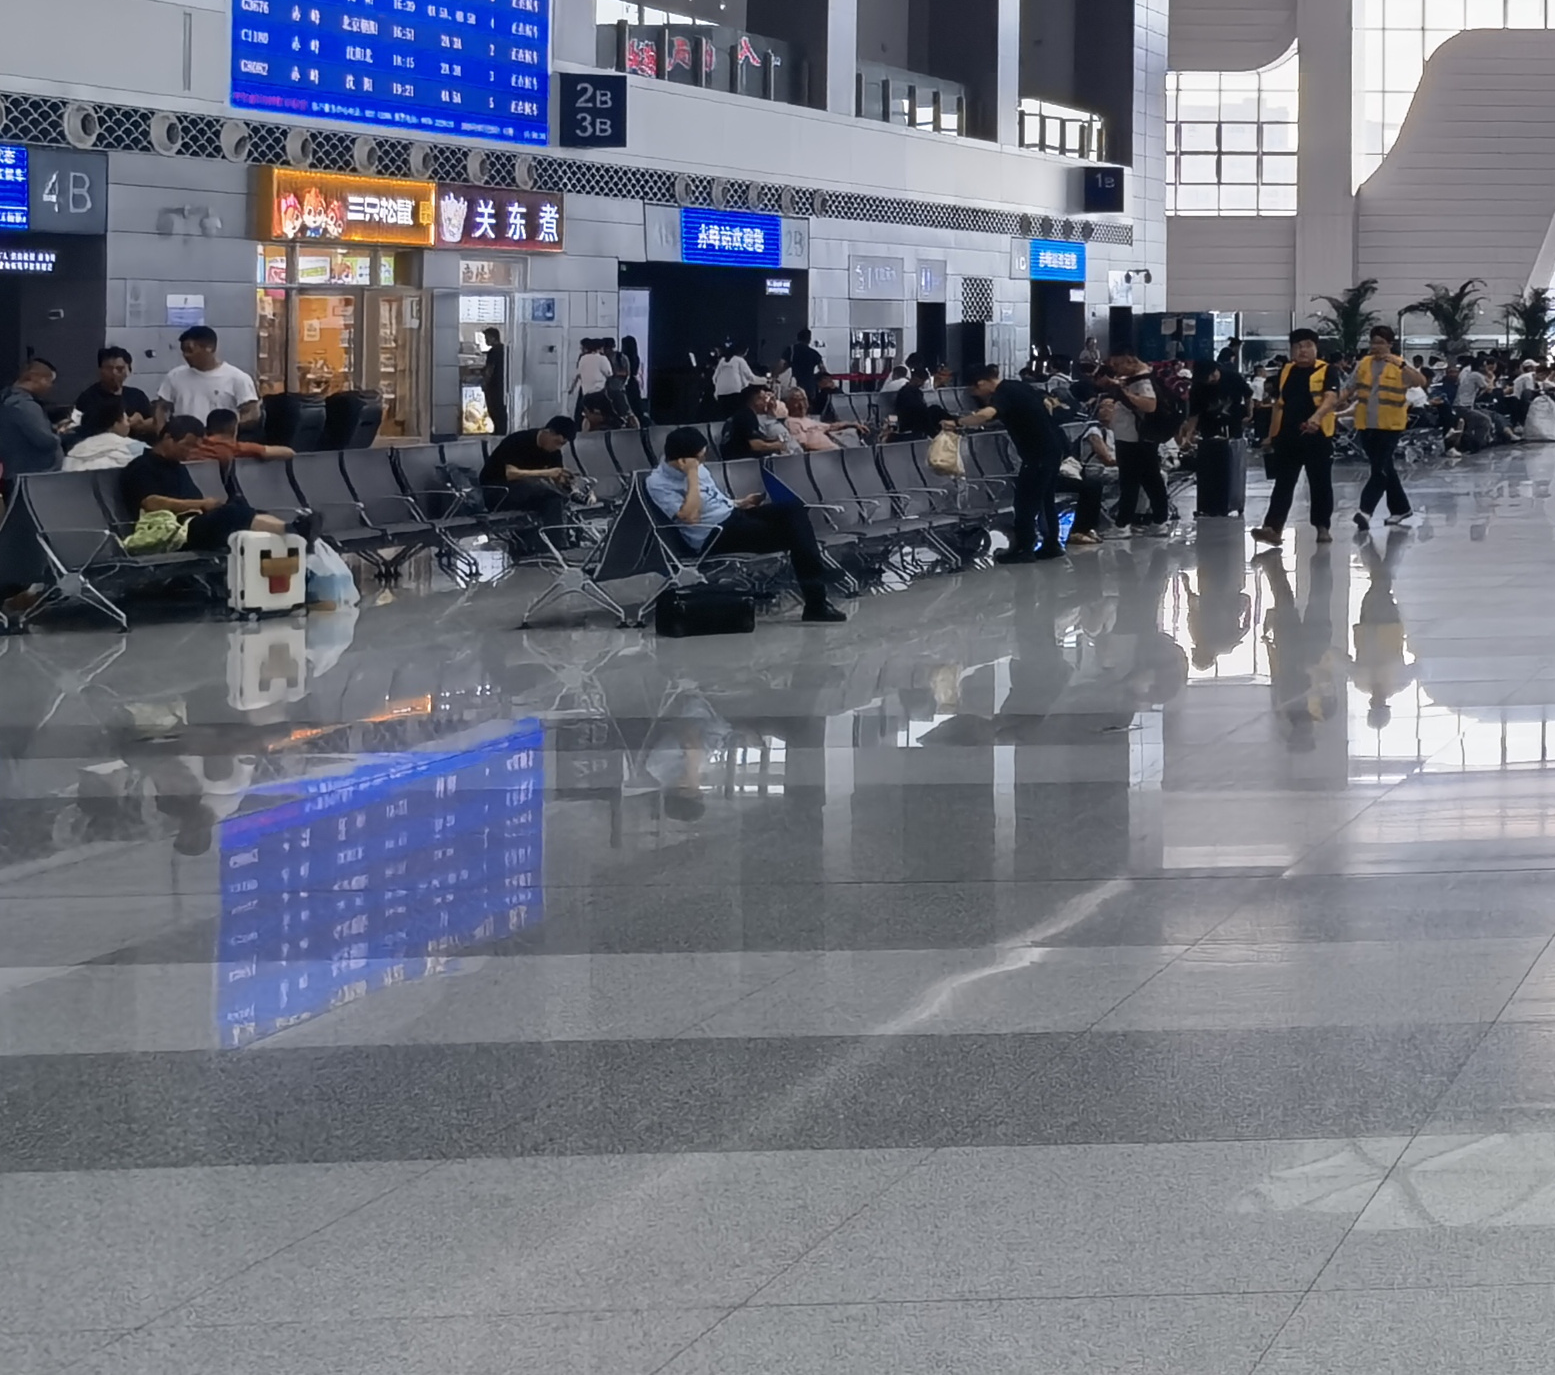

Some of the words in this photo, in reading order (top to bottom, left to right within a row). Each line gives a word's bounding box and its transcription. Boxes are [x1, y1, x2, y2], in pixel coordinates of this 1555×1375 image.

[575, 83, 612, 108] 2B
[575, 113, 612, 137] 3B
[43, 170, 92, 214] 4B
[1096, 172, 1115, 189] 1B
[347, 197, 414, 225] 三只松鼠
[471, 199, 559, 242] 关东煮
